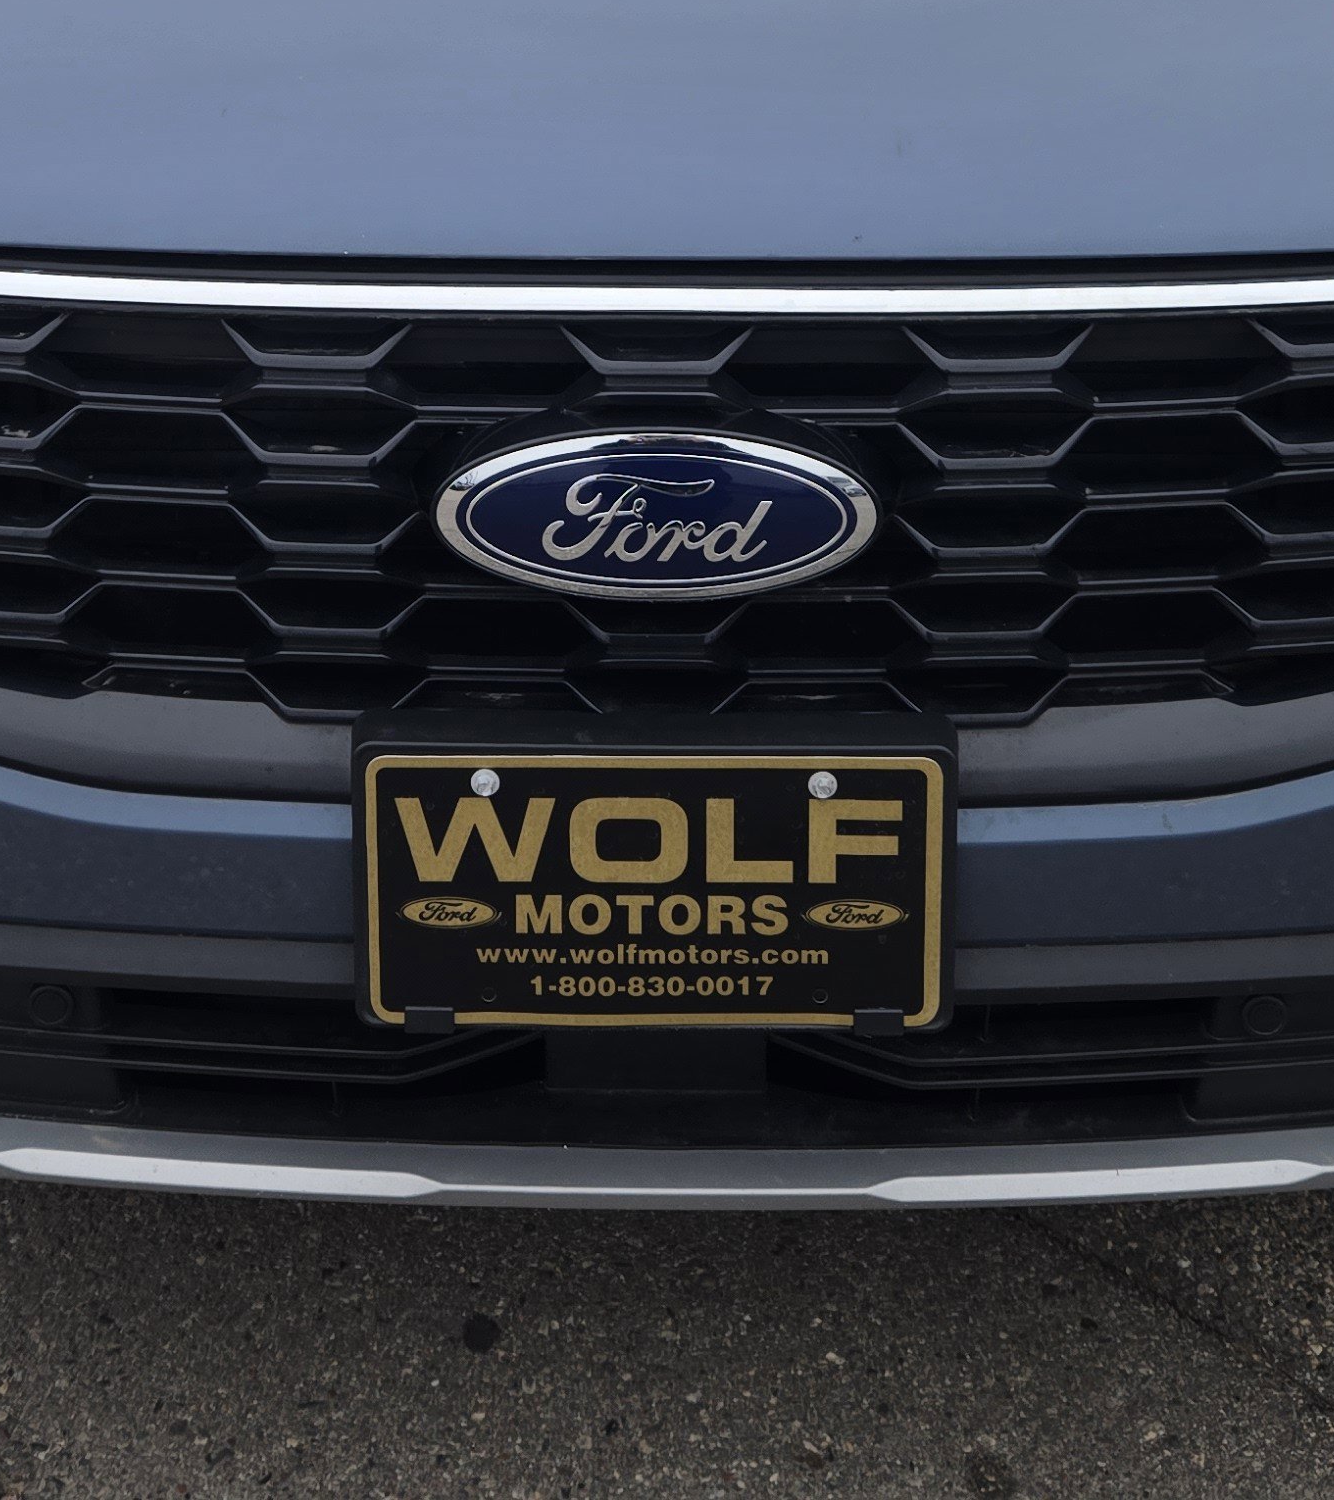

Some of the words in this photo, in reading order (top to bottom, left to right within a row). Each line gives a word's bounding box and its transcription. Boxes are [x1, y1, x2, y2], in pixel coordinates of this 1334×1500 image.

[541, 472, 773, 563] Ford
[394, 796, 904, 884] WOLF
[418, 901, 478, 923] Ford
[515, 894, 790, 936] MOTORS
[825, 903, 885, 925] Ford
[476, 943, 830, 966] www.wolfmotors.com
[529, 975, 775, 998] 1-800-830-0017
